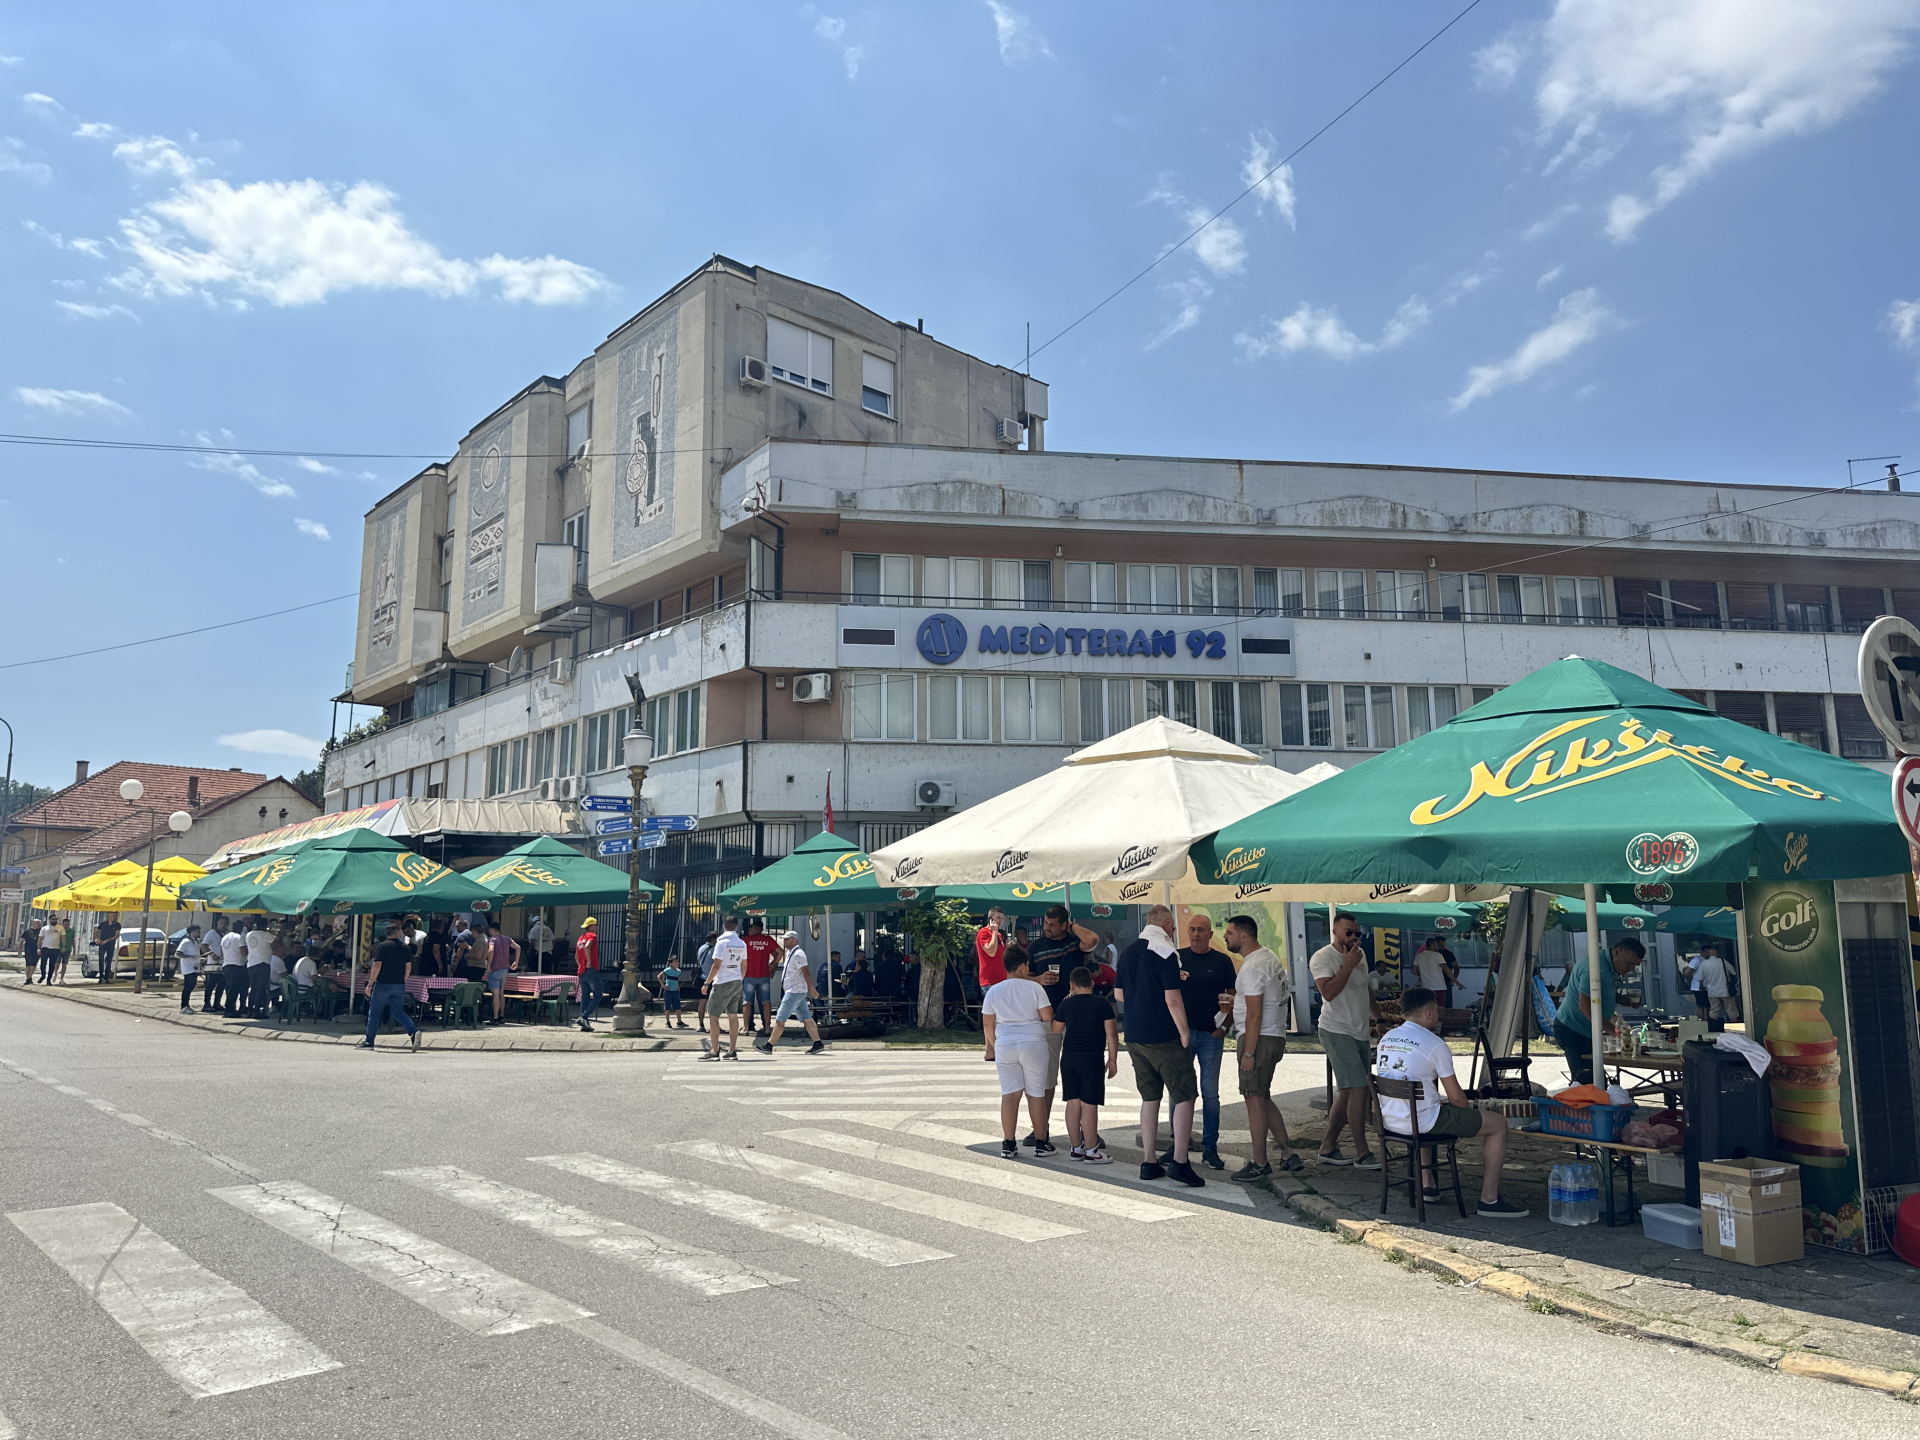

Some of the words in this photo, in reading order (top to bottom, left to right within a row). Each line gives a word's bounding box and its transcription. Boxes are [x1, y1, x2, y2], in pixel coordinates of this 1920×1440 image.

[979, 624, 1176, 658] MEDITERAN
[1186, 629, 1227, 659] 92
[1410, 714, 1826, 826] Nikšićko
[991, 849, 1031, 879] Nikšićko
[1111, 845, 1159, 876] Nikšićko
[1213, 846, 1267, 880] Nikšićko
[1640, 841, 1685, 865] 1896
[890, 856, 924, 883] Nikšićko
[74, 902, 96, 910] 1756
[1118, 881, 1154, 901] Nikšićko
[1760, 898, 1814, 937] Golf
